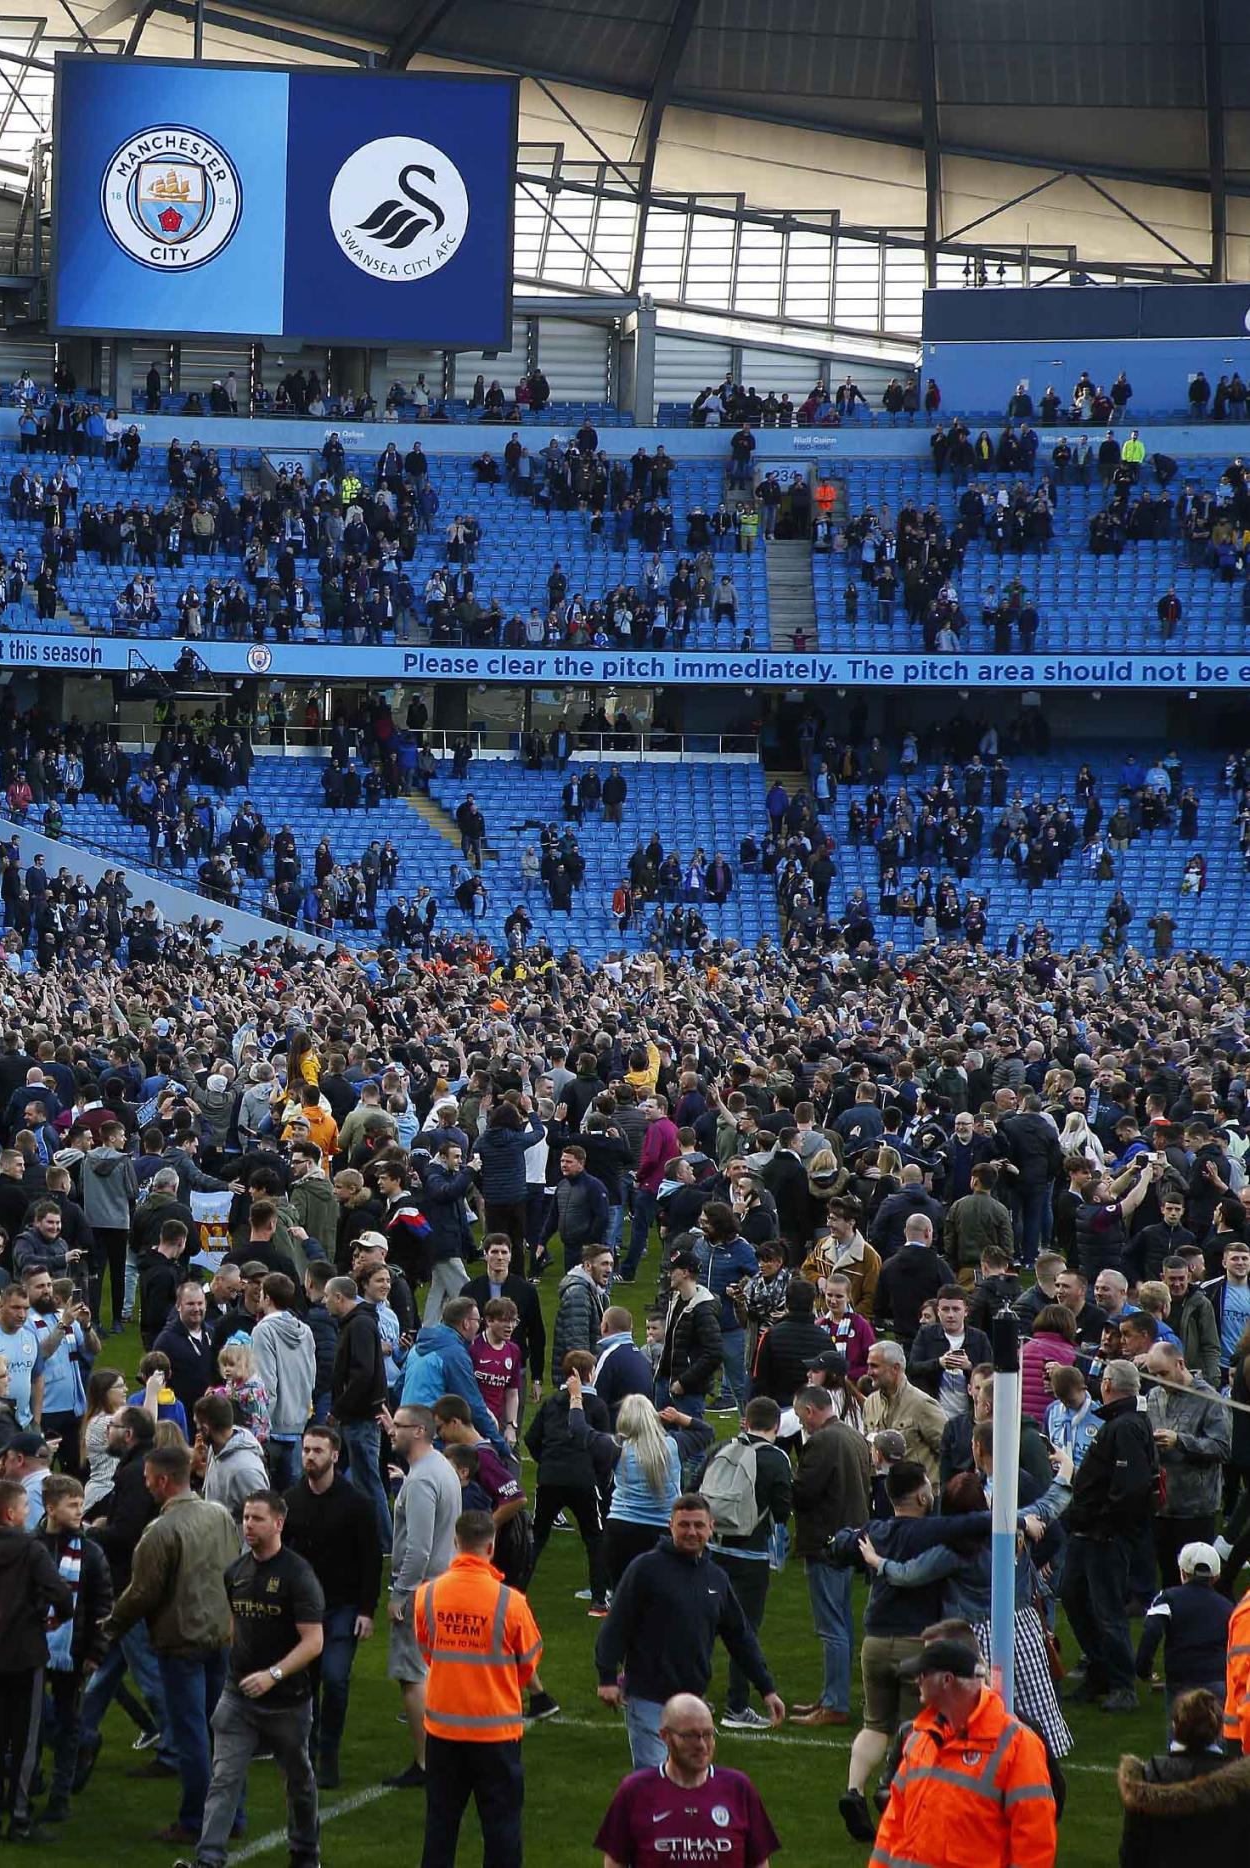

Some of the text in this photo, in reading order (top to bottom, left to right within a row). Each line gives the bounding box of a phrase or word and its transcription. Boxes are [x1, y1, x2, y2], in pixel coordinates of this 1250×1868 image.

[117, 135, 226, 183] MANCHESTER
[111, 192, 122, 200] 18
[150, 246, 190, 262] CITY
[340, 228, 457, 277] SWANSEA CITY AFC
[9, 640, 37, 660] this
[43, 646, 102, 664] season
[404, 653, 478, 673] Please
[487, 655, 546, 674] clear
[554, 656, 594, 676] the
[603, 657, 664, 679] pitch
[675, 658, 837, 682] immediately.
[847, 660, 894, 679] The
[904, 660, 968, 683] pitch
[978, 665, 1034, 680] area
[1044, 661, 1132, 680] should
[1142, 662, 1186, 681] not
[1196, 662, 1229, 681] be
[498, 1480, 518, 1495] NEXEN
[437, 1612, 488, 1627] SAFETY
[444, 1624, 480, 1638] TEAM
[654, 1837, 732, 1852] ETIHAD
[670, 1852, 718, 1862] AIRWAYS
